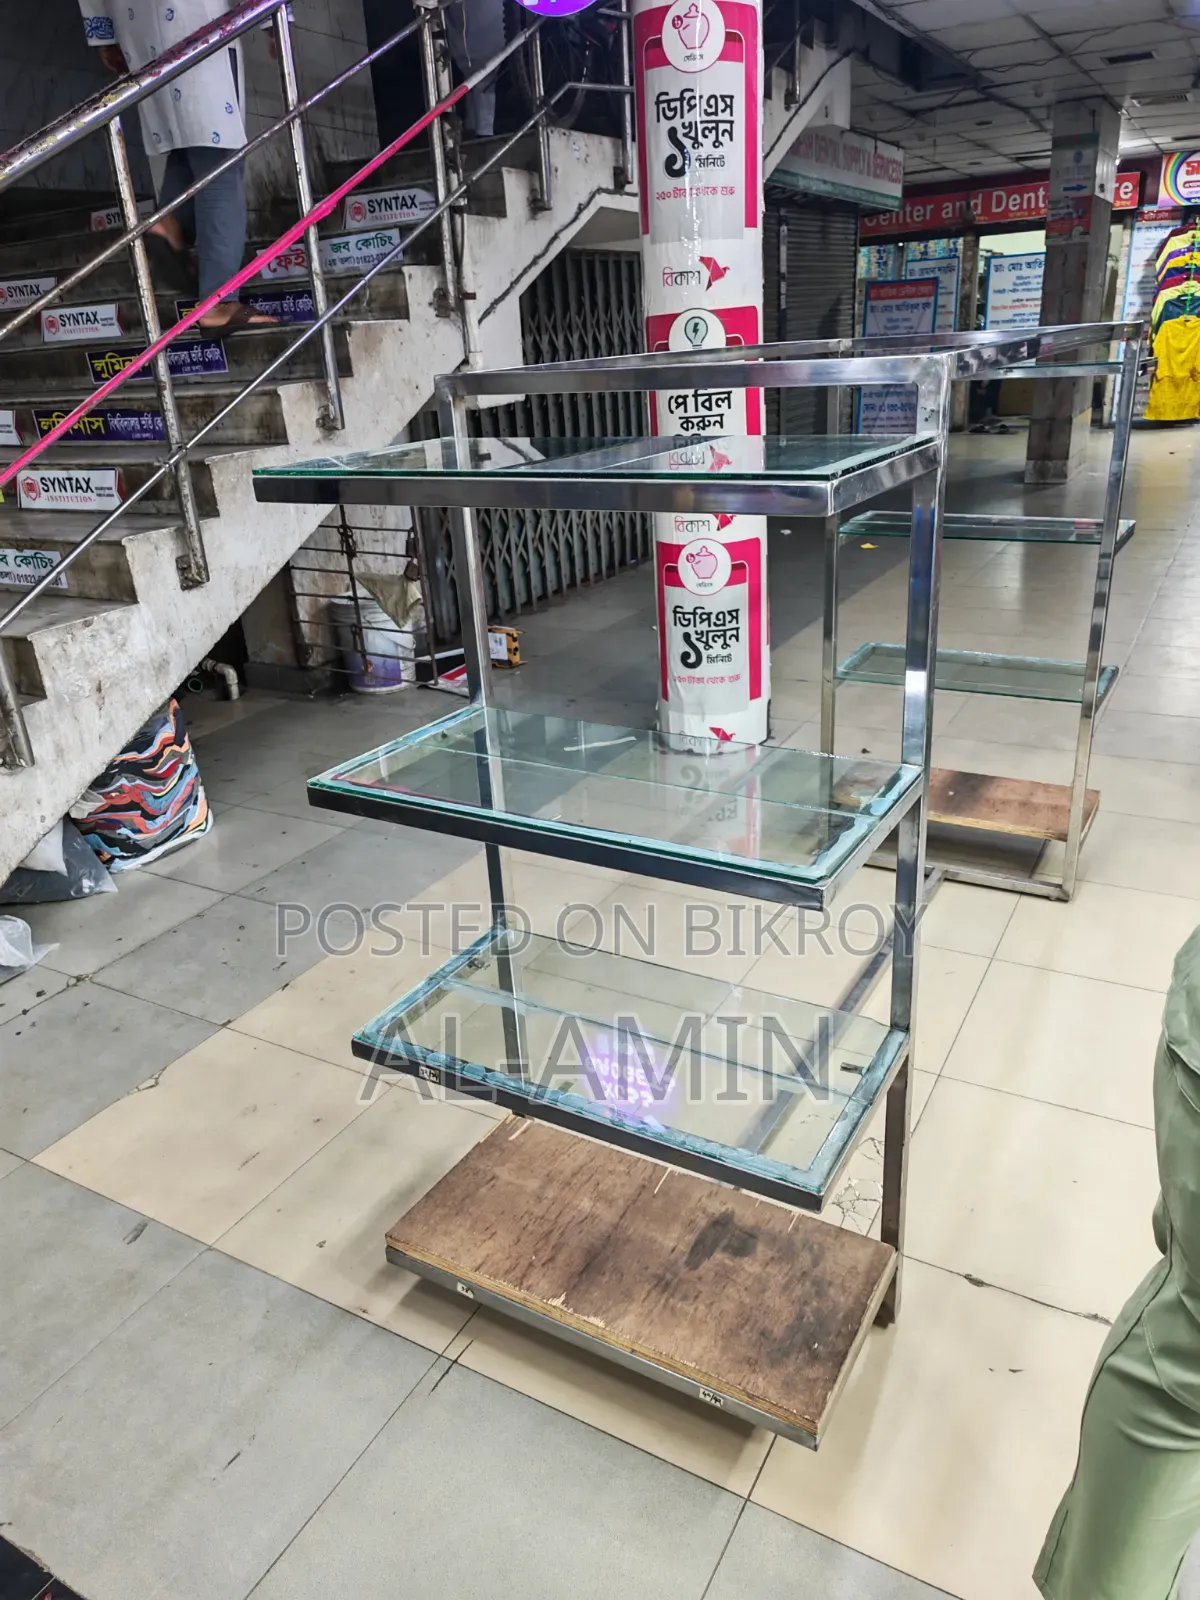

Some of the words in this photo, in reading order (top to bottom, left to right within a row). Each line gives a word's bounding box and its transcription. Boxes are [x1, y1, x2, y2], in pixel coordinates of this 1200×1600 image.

[655, 88, 735, 123] ডিপিএস
[682, 119, 735, 149] খুলুন
[695, 154, 726, 168] মিনিটে
[367, 194, 418, 214] SYNTAX
[942, 193, 982, 219] and
[991, 185, 1049, 213] Dent
[330, 240, 351, 254] জব
[355, 232, 397, 251] কোচিং
[6, 284, 42, 298] SYNTAX
[58, 310, 100, 328] SYNTAX
[668, 394, 689, 414] পে
[692, 388, 733, 413] বিল
[678, 413, 725, 432] করুন
[39, 477, 94, 494] SYNTAX
[674, 516, 711, 532] বিকাশ
[14, 551, 54, 570] কোচিং
[673, 605, 740, 628] ডিপিএস
[695, 625, 740, 651] খুলুন
[680, 631, 703, 669] ১
[706, 653, 733, 665] মিনিটে
[687, 673, 705, 685] টাকা
[706, 674, 726, 685] থেকে
